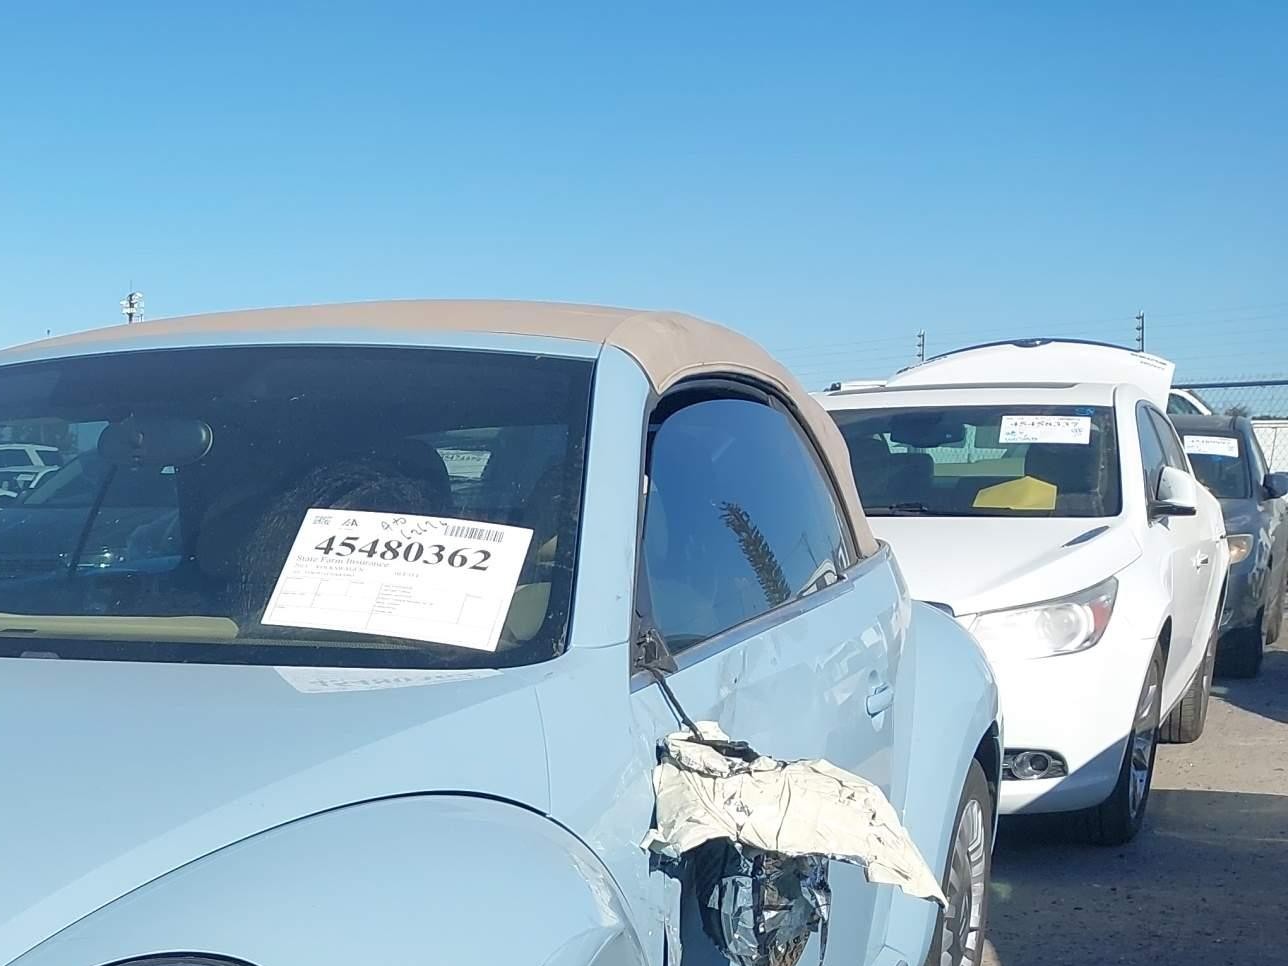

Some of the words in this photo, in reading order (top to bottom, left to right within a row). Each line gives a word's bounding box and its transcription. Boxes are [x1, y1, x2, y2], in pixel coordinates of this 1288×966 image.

[297, 554, 318, 563] State
[320, 556, 344, 565] Farm
[346, 558, 391, 569] Insurance
[314, 534, 492, 571] 45480362
